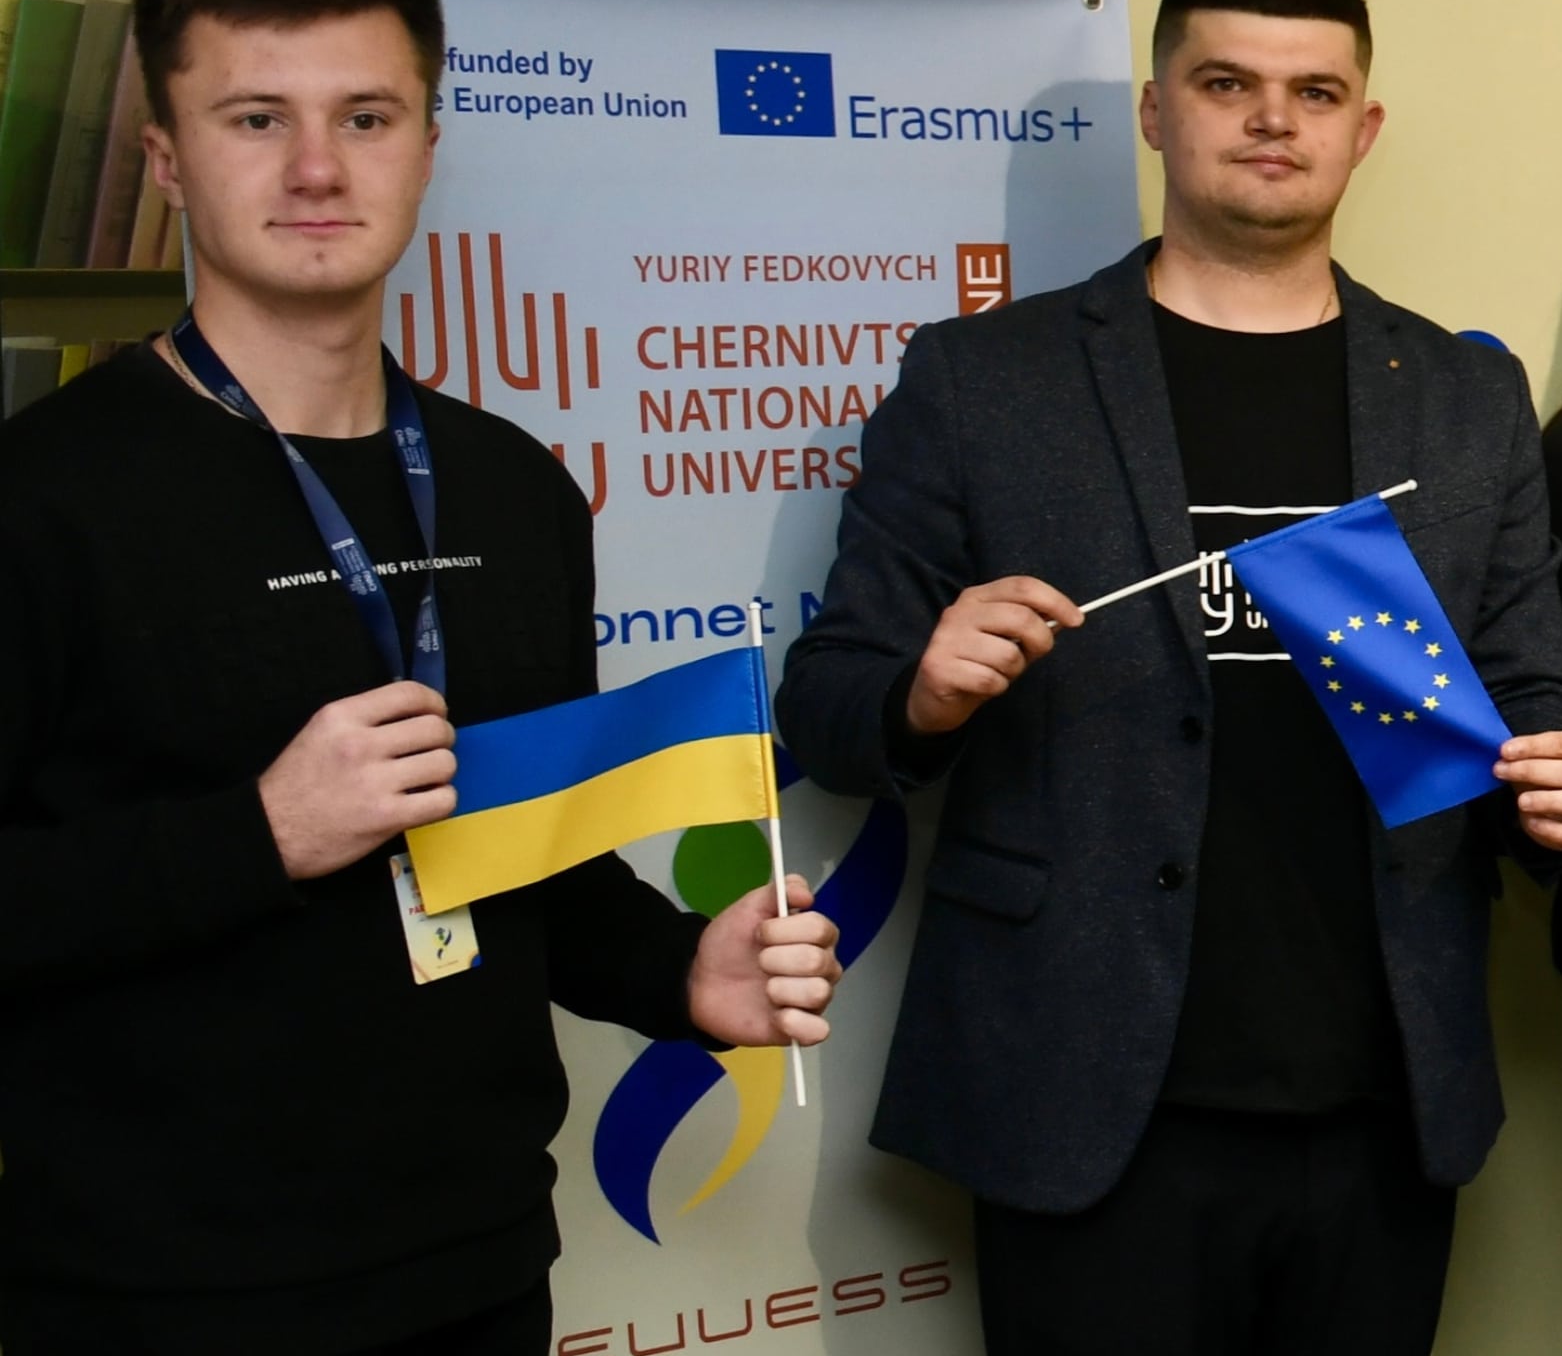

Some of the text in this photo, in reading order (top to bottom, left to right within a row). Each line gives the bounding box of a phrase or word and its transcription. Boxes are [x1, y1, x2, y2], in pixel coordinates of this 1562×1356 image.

[446, 46, 594, 83] funded by
[453, 86, 595, 121] European
[603, 92, 688, 119] Union
[848, 95, 1094, 143] Erasmus+
[633, 254, 937, 283] YURIY FEDKOVYCH
[638, 384, 884, 434] NATIONA
[267, 569, 328, 591] HAVING
[400, 555, 482, 573] PERSONALITY
